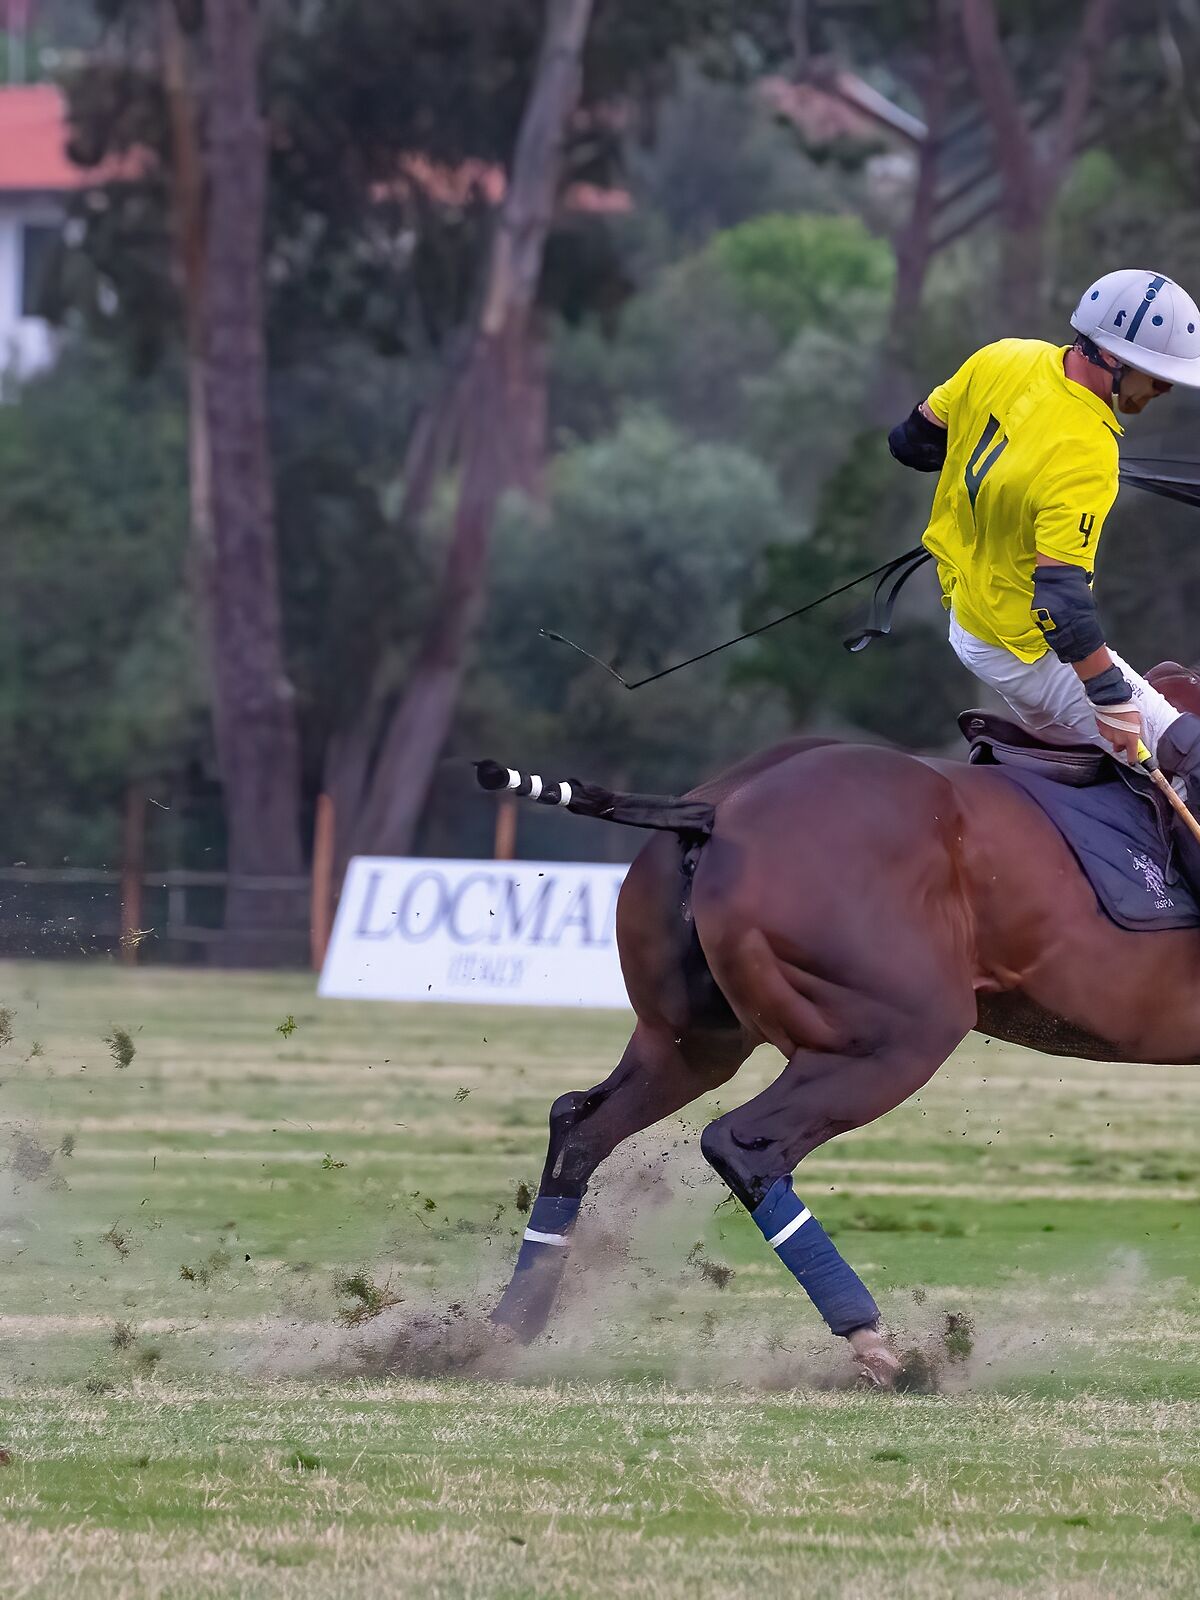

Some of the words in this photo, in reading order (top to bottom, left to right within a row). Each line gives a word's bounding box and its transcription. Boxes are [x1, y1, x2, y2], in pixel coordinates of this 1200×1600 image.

[1078, 512, 1096, 548] 4
[353, 868, 619, 948] LOCMA
[1154, 898, 1175, 910] USPA
